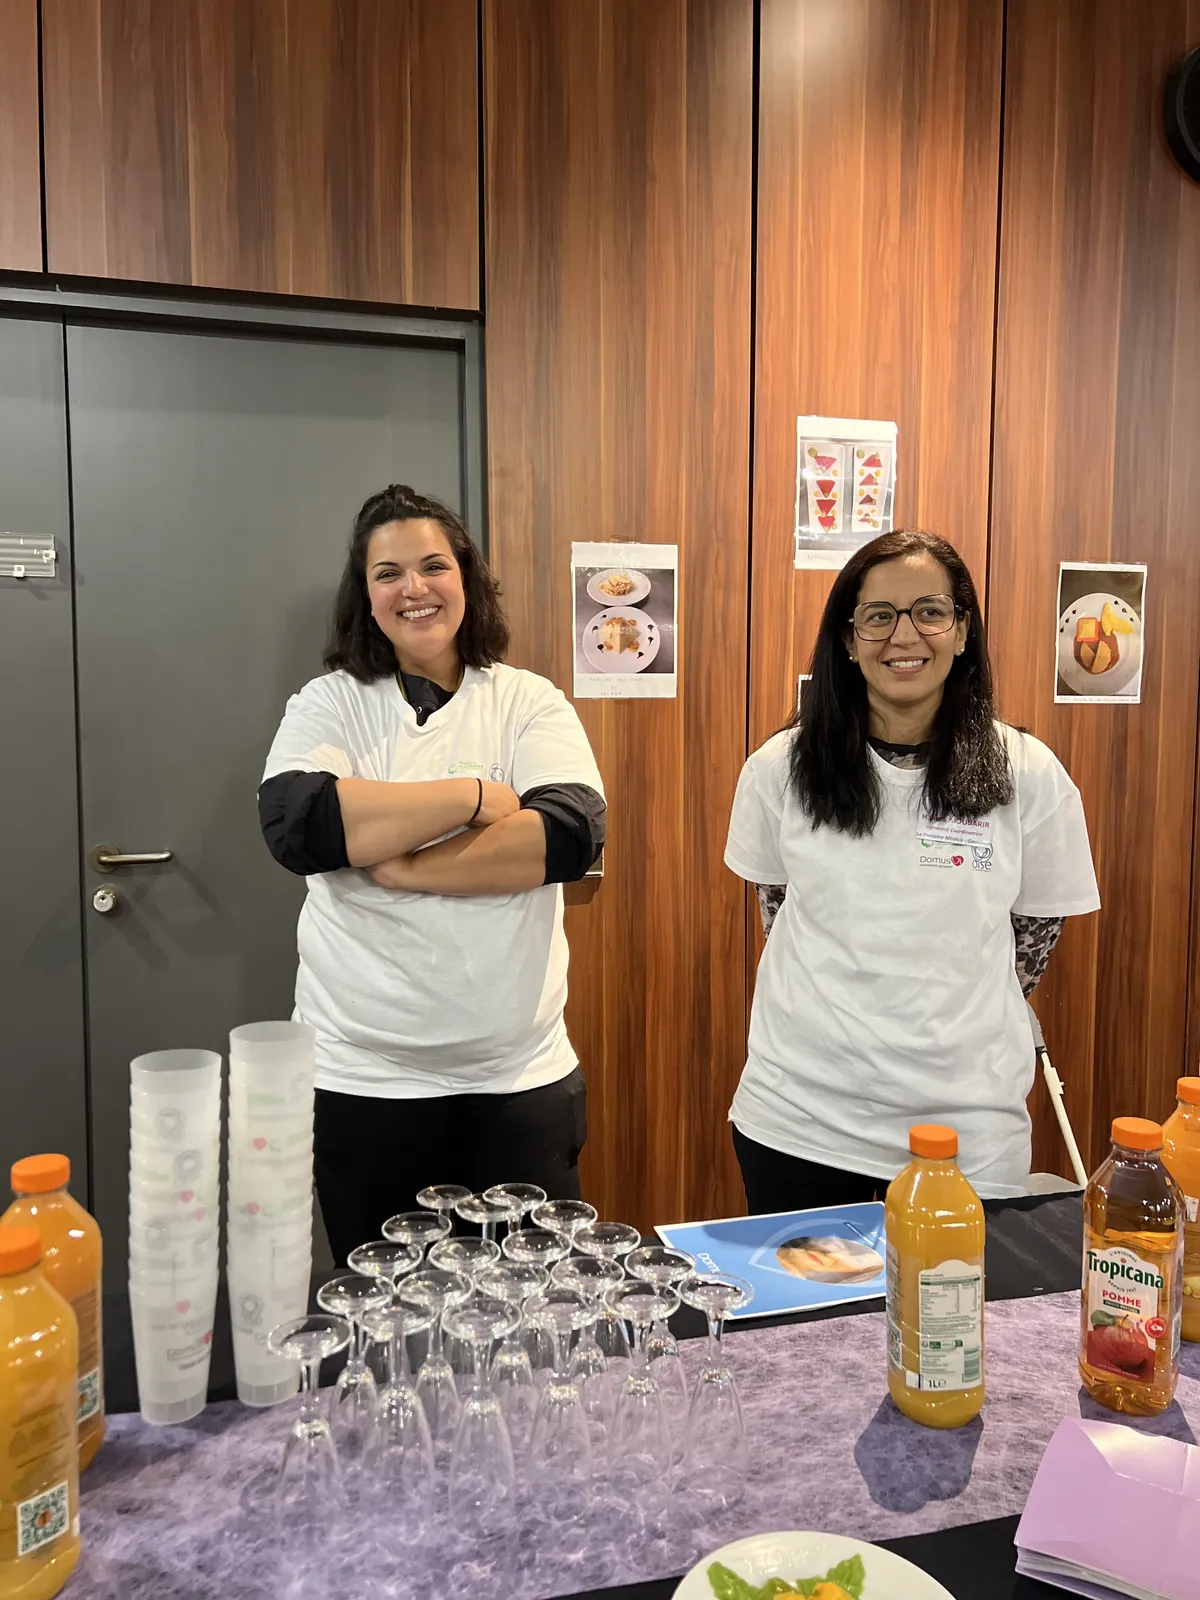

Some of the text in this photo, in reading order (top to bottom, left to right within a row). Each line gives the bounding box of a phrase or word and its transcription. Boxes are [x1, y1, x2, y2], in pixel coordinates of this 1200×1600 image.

[920, 855, 952, 865] Domus
[1086, 1250, 1164, 1289] Tropicana
[1102, 1289, 1142, 1308] POMME
